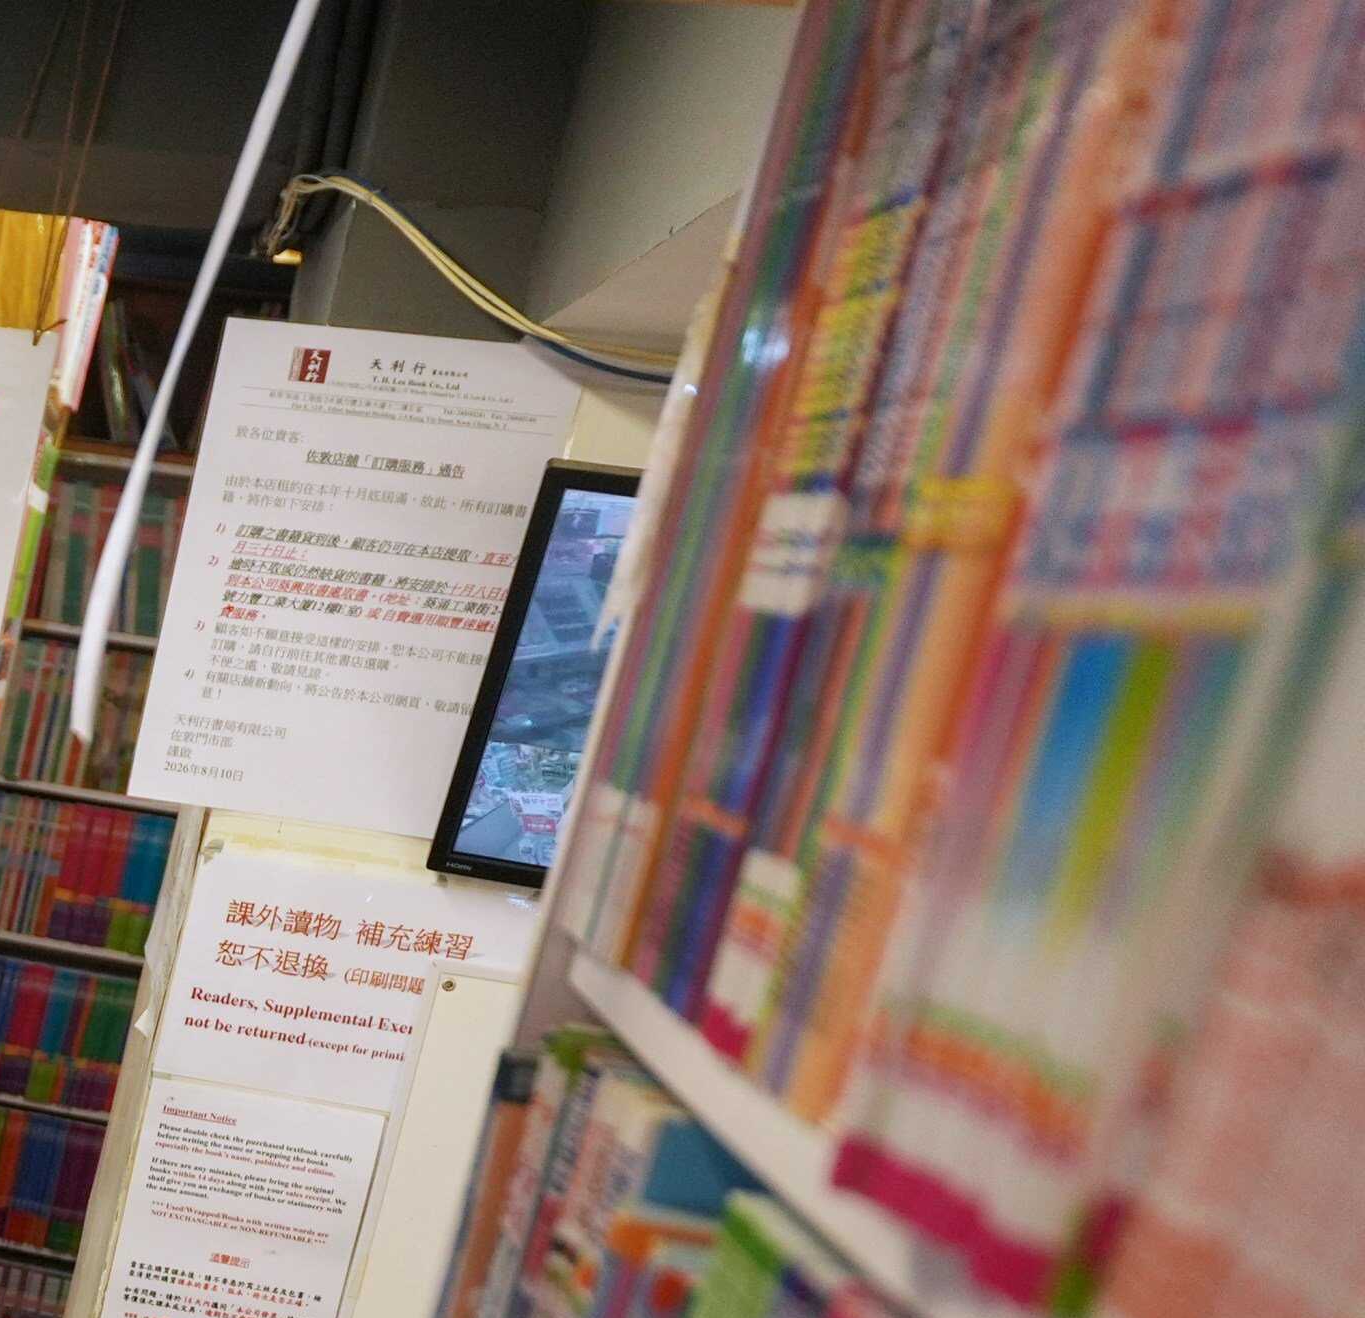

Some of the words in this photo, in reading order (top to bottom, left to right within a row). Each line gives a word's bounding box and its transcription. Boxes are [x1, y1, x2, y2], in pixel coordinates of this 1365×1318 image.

[369, 356, 427, 375] 天利行
[162, 761, 244, 781] 2026年8月10日
[225, 897, 343, 942] 課外讀物
[354, 916, 474, 962] 補充練習
[214, 938, 331, 981] 恕不退換
[191, 987, 257, 1011] Readers,
[262, 998, 372, 1031] Supplemental
[184, 1014, 211, 1030] not
[213, 1018, 232, 1032] be
[237, 1022, 306, 1046] returned
[307, 1037, 349, 1055] (except
[351, 1043, 369, 1056] for
[162, 1103, 208, 1119] Important
[209, 1113, 237, 1125] Notice
[157, 1131, 179, 1141] before
[181, 1135, 208, 1146] writing
[255, 1148, 291, 1161] wrapping
[292, 1155, 304, 1163] the
[183, 1126, 208, 1137] double
[209, 1131, 231, 1141] check
[232, 1135, 243, 1143] the
[245, 1138, 284, 1151] purchased
[285, 1145, 318, 1157] textbook
[319, 1151, 352, 1163] carefully
[159, 1157, 178, 1167] there
[193, 1164, 206, 1172] any
[244, 1173, 267, 1183] please
[268, 1178, 289, 1187] bring
[290, 1182, 302, 1190] the
[183, 1180, 196, 1188] you
[208, 1184, 242, 1196] exchange
[226, 1178, 246, 1188] along
[248, 1182, 265, 1191] with
[266, 1186, 283, 1195] your
